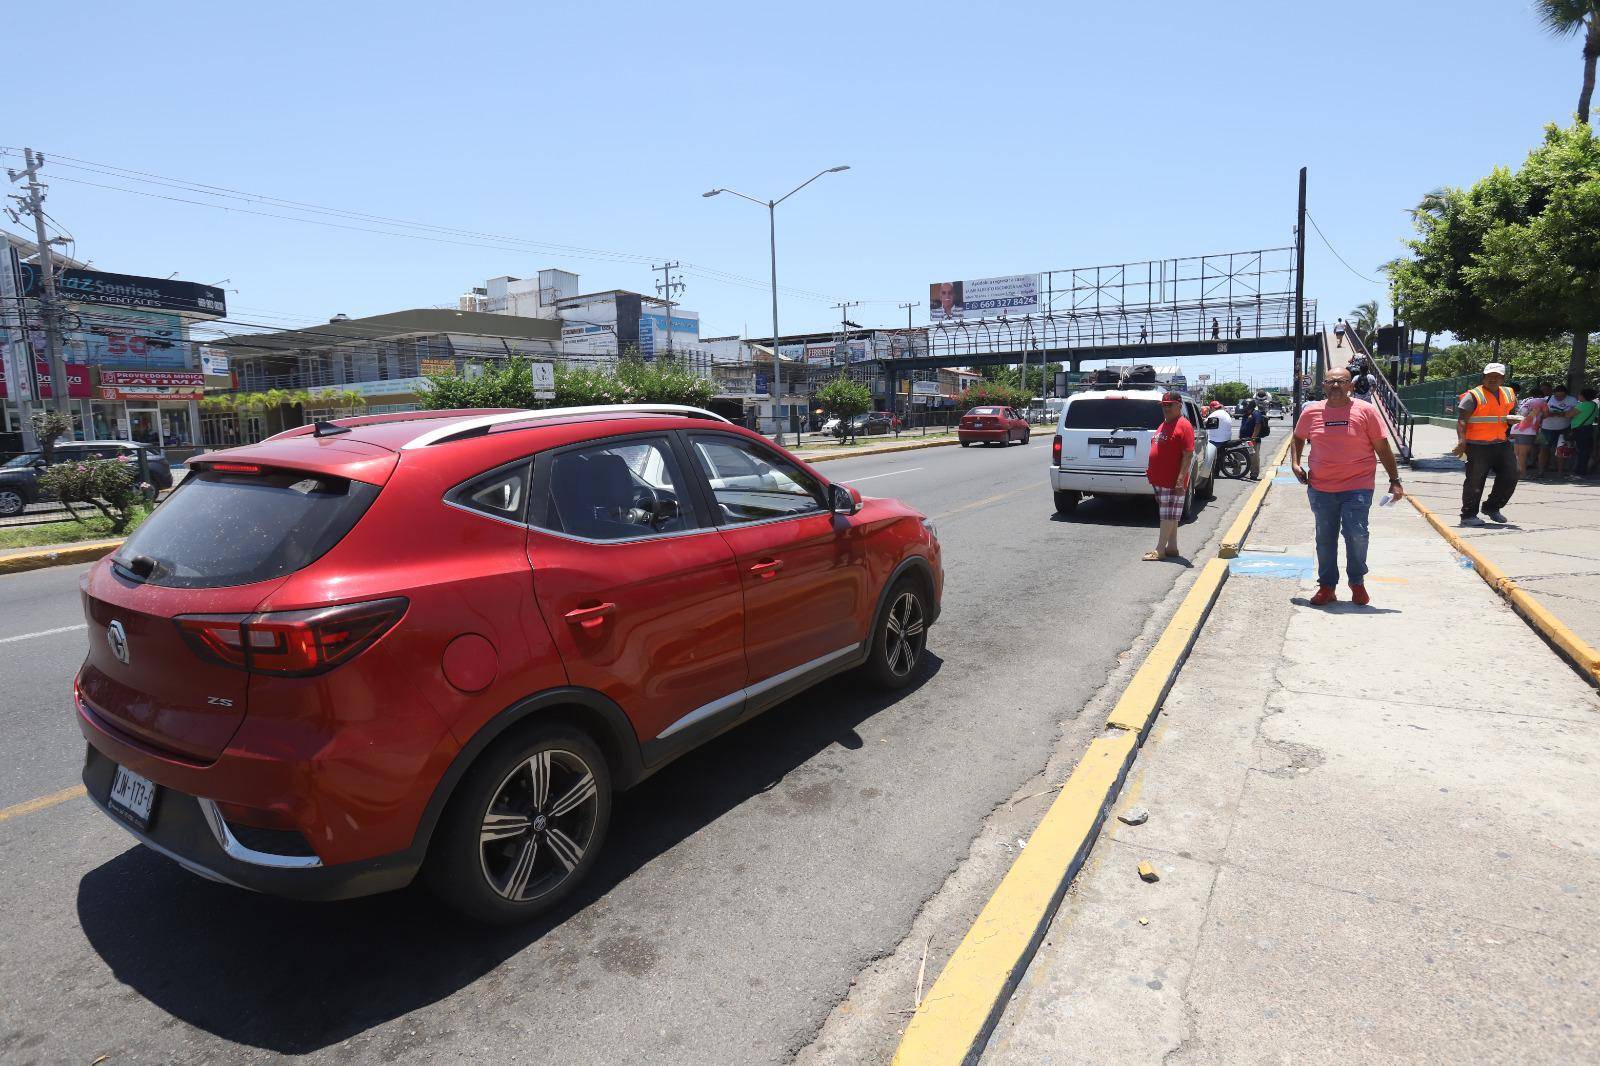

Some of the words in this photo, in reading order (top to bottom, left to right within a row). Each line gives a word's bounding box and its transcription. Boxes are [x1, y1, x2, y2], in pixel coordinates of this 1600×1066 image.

[96, 280, 160, 298] Sonrisas
[980, 300, 995, 309] 669
[996, 299, 1011, 307] 327
[208, 696, 233, 707] ZS
